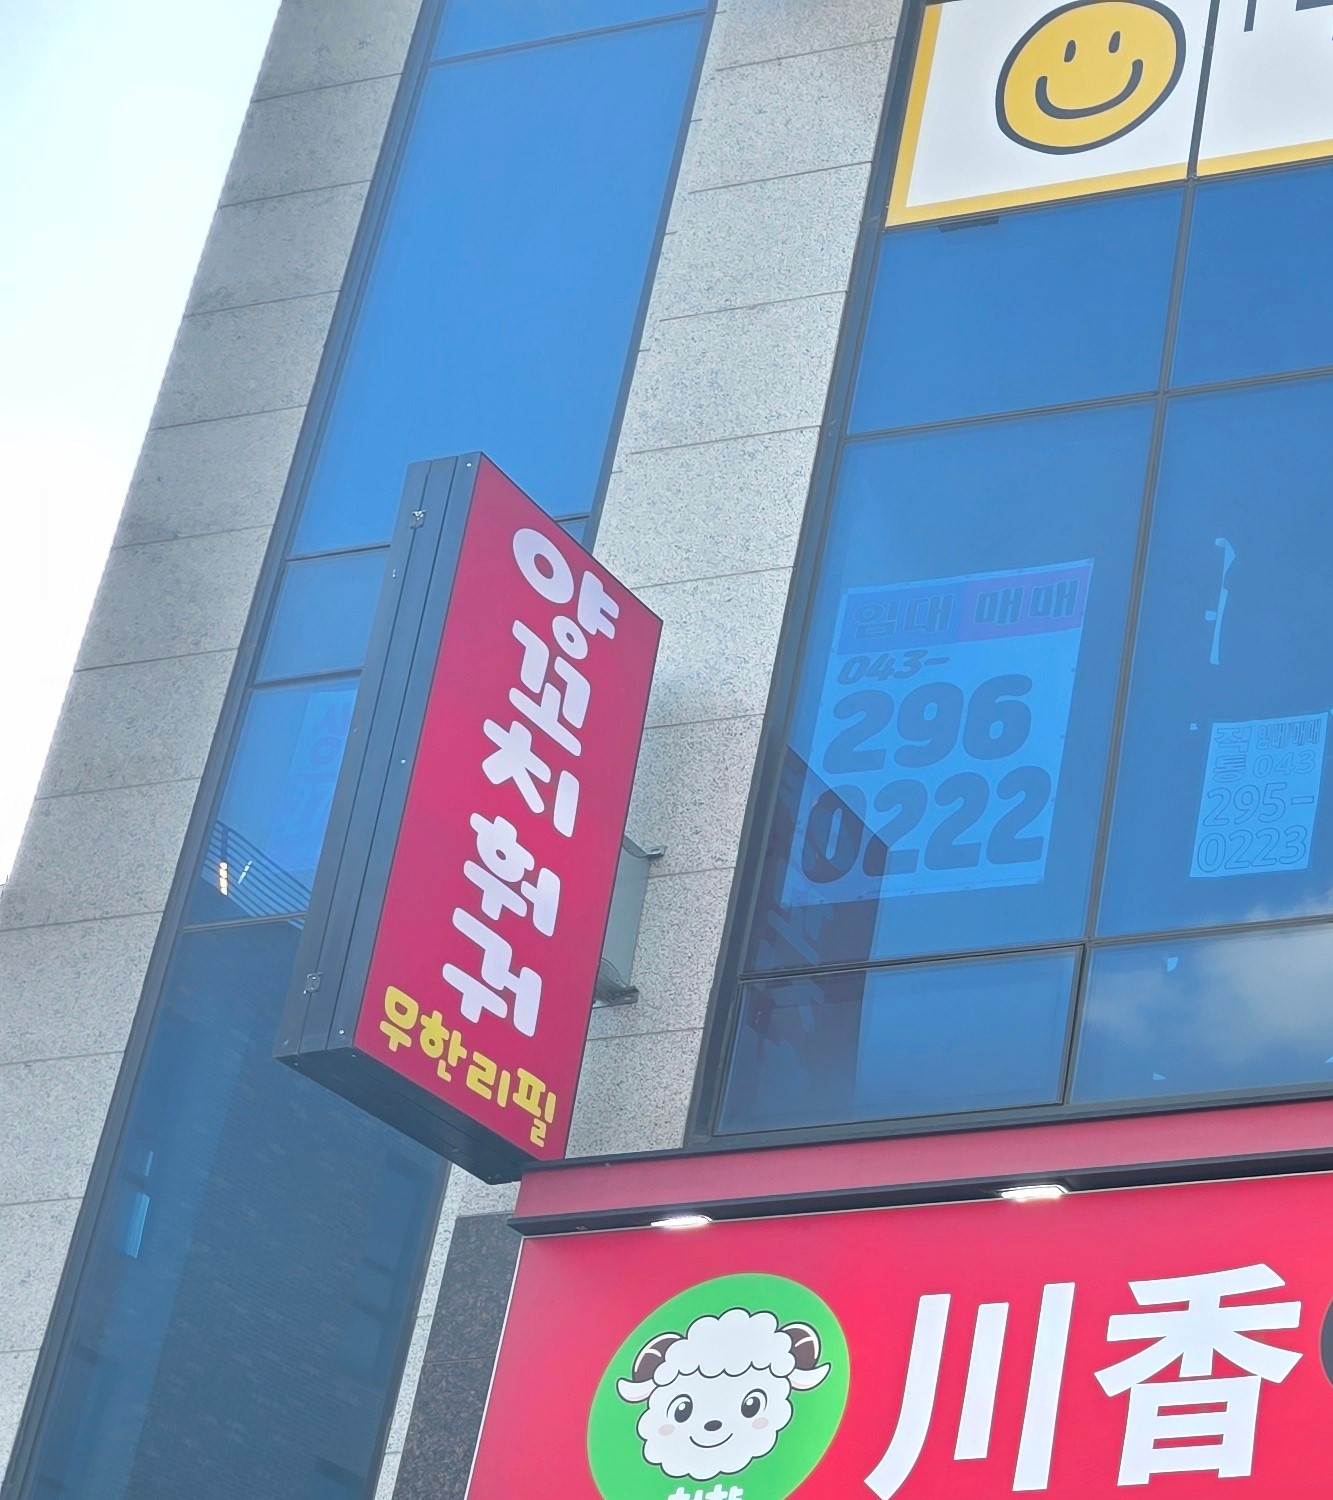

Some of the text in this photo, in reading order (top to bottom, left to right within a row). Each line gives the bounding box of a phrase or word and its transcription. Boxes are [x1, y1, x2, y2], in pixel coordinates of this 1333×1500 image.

[973, 579, 1081, 626] 매매
[838, 649, 950, 686] 043-
[822, 673, 1033, 775] 296
[1253, 750, 1315, 778] 043
[801, 765, 1051, 885] 0222
[1203, 782, 1314, 827] 295-
[1197, 825, 1308, 872] 0223
[379, 986, 557, 1147] 무한리필
